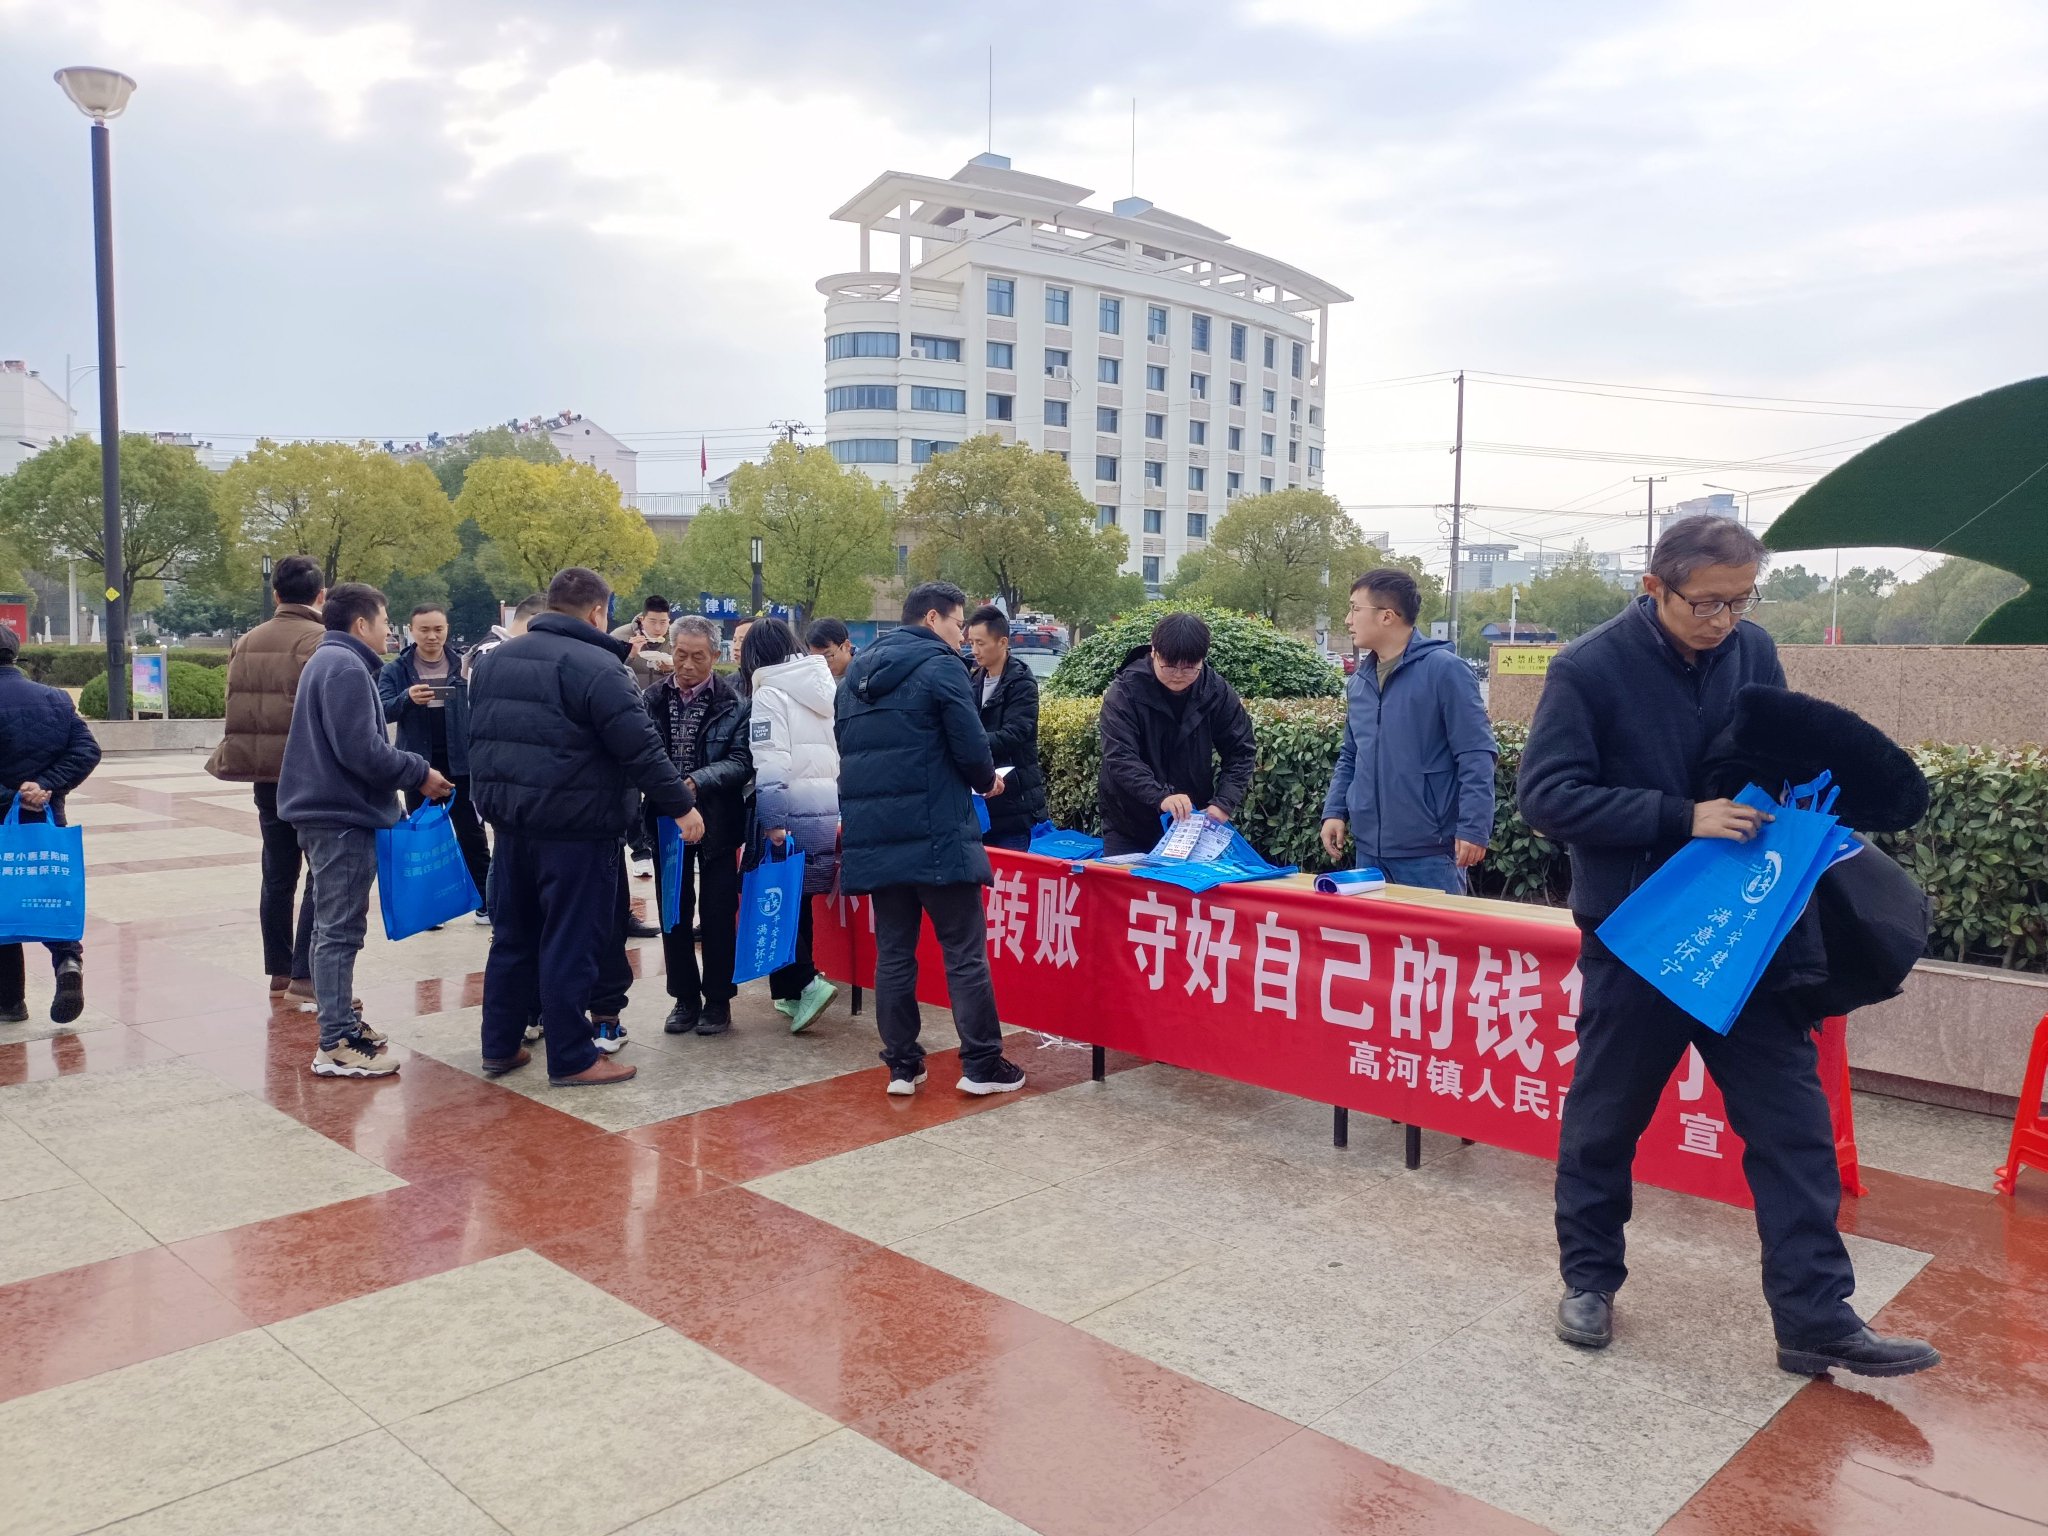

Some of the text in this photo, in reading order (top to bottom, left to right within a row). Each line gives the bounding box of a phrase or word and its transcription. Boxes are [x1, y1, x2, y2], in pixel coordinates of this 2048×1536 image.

[0, 865, 71, 877] 离诈骗保平安
[1660, 906, 1733, 976] 满意怀宁
[1692, 907, 1758, 989] 平安建设
[1678, 1112, 1725, 1160] 宣
